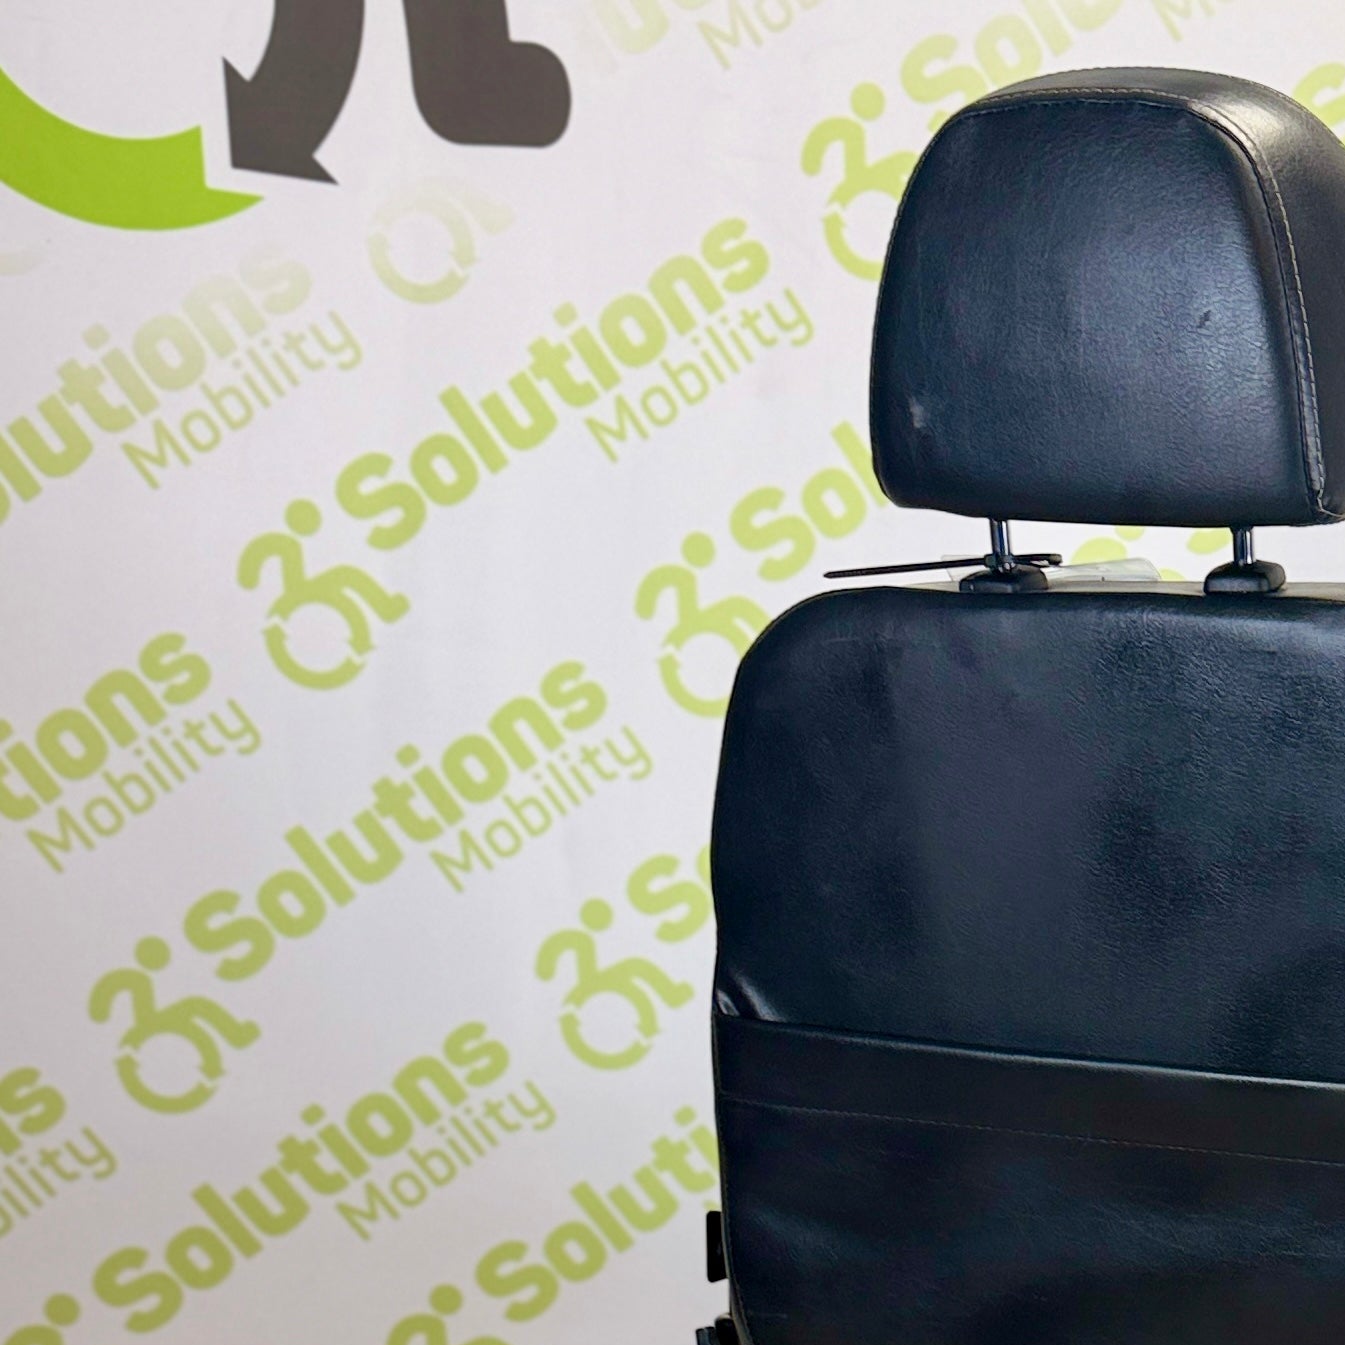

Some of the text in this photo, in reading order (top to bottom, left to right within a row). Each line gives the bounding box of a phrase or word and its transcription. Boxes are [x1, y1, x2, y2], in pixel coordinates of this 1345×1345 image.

[0, 243, 313, 530] lutions
[121, 309, 363, 491] Mobility
[335, 217, 771, 551] Solutions
[585, 287, 814, 464] Mobility
[26, 698, 262, 874] Mobility
[184, 660, 607, 983] Solutions
[429, 724, 654, 893] Mobility
[93, 1021, 510, 1334] Solutions
[335, 1079, 558, 1243] Mobility
